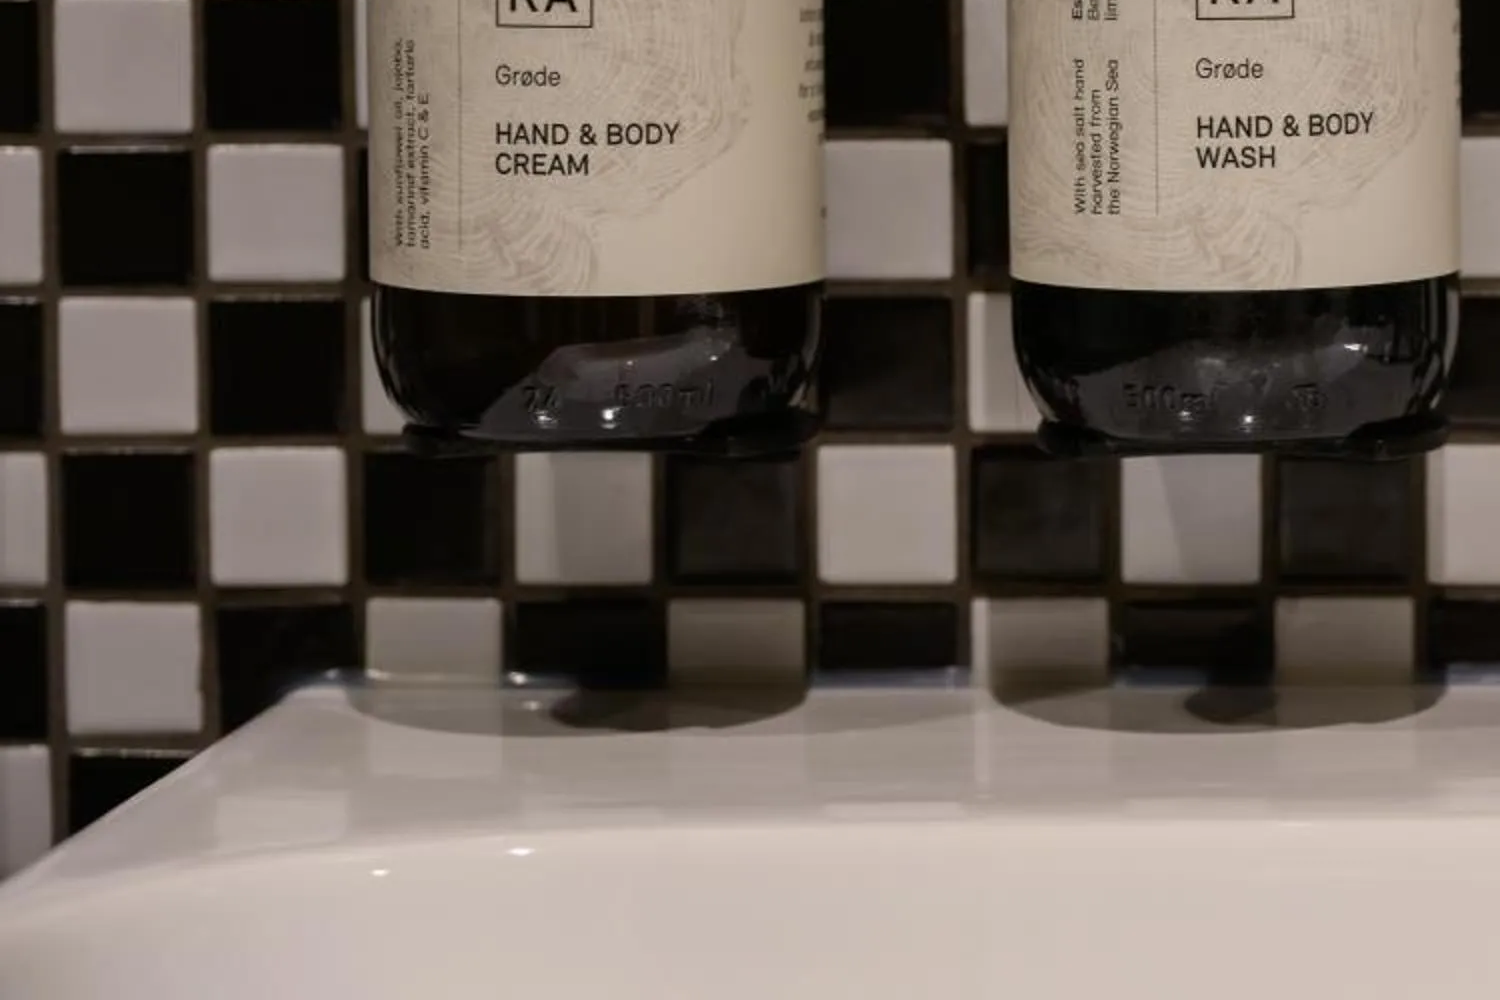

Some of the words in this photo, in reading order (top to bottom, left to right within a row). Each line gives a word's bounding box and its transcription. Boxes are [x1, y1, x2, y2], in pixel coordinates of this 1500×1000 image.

[495, 63, 562, 89] Grøde
[1072, 58, 1084, 100] hand
[1104, 59, 1119, 93] Sea
[1195, 56, 1265, 80] Grøde
[417, 92, 429, 105] E
[1088, 89, 1102, 127] from
[417, 108, 429, 124] &
[1072, 106, 1084, 137] salt
[1197, 115, 1274, 139] HAND
[1283, 114, 1302, 138] &
[1308, 111, 1375, 137] BODY
[417, 126, 429, 142] C
[495, 123, 569, 146] HAND
[579, 123, 598, 146] &
[606, 121, 681, 146] BODY
[1106, 97, 1123, 184] Norwegian
[495, 152, 590, 176] CREAM
[1073, 141, 1085, 171] sea
[1197, 145, 1276, 169] WASH
[417, 145, 429, 205] vitamin
[1088, 132, 1103, 216] harvested
[1073, 177, 1085, 216] With
[1106, 189, 1121, 216] the
